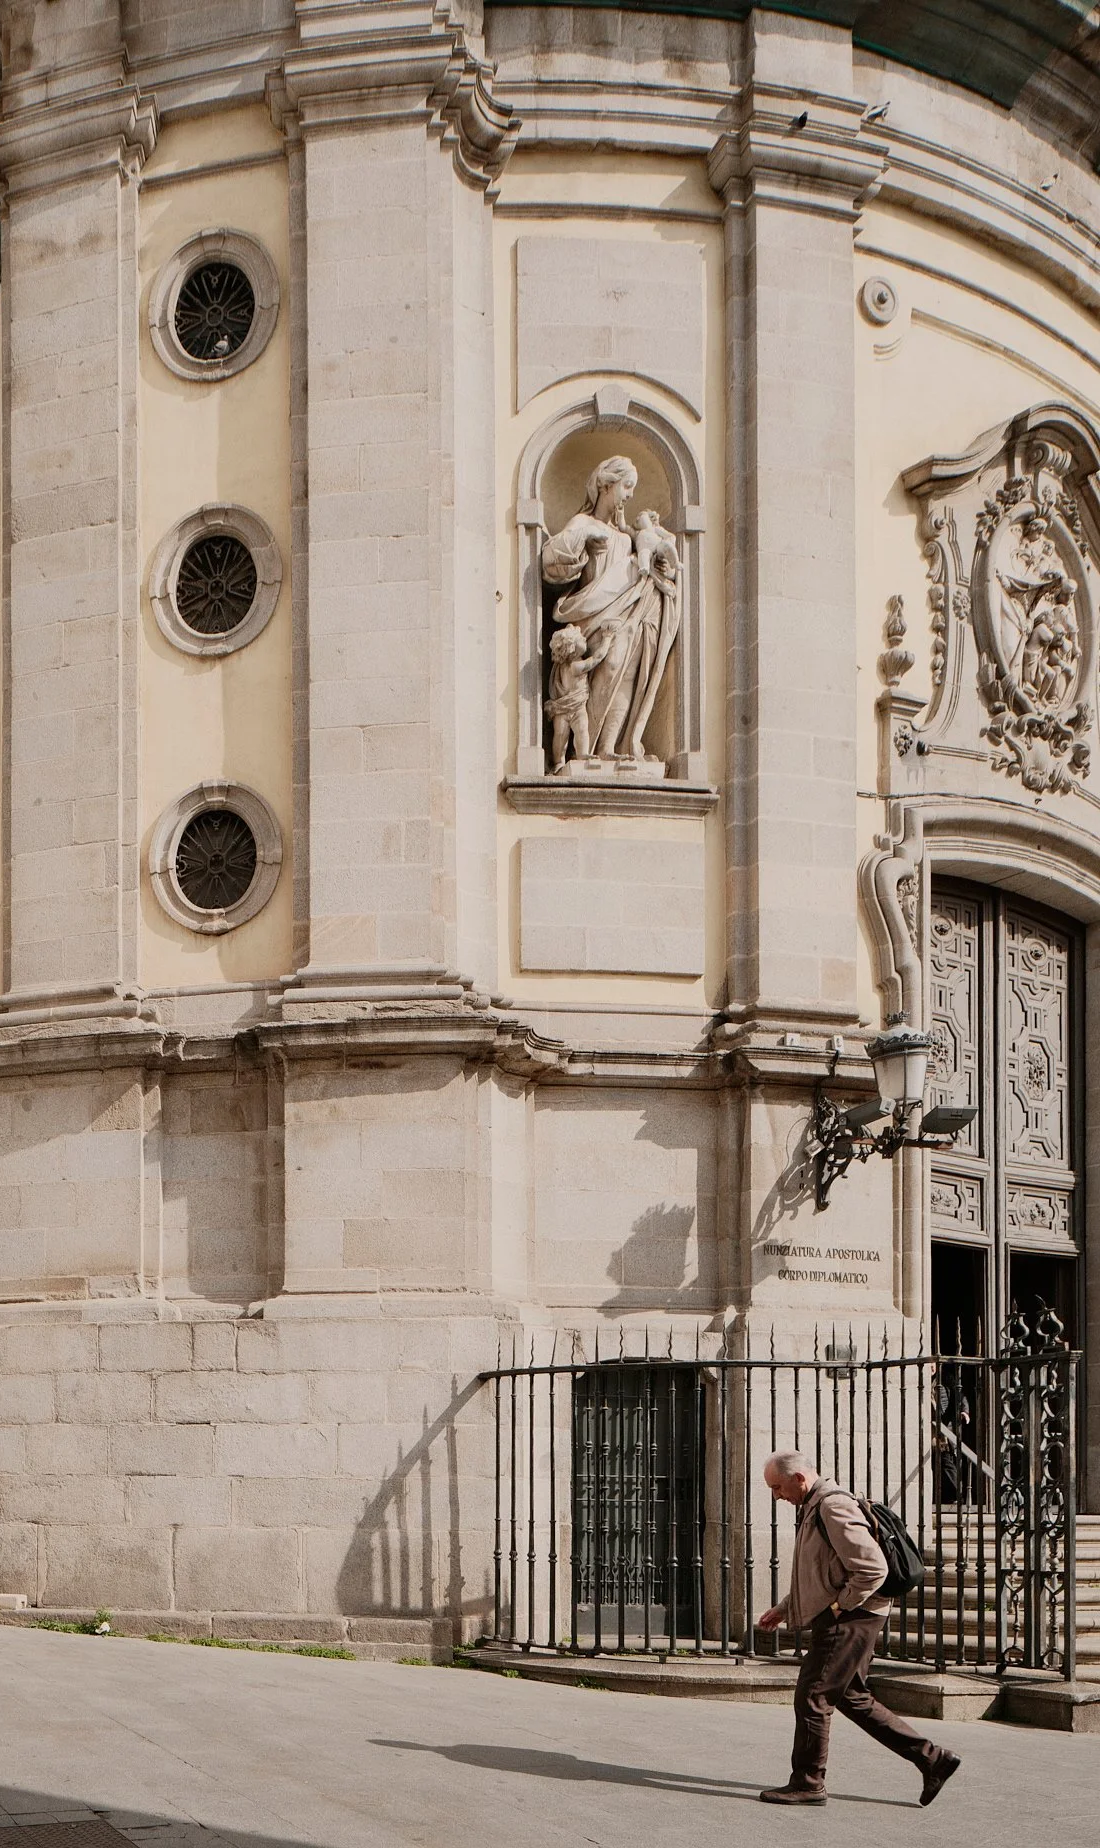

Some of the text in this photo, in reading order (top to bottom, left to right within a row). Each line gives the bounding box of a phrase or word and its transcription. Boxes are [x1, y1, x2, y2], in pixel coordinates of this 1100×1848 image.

[763, 1244, 881, 1262] NUNZIATURA APOSTOLICA
[778, 1269, 868, 1284] CORPO DIPLOMATICO
